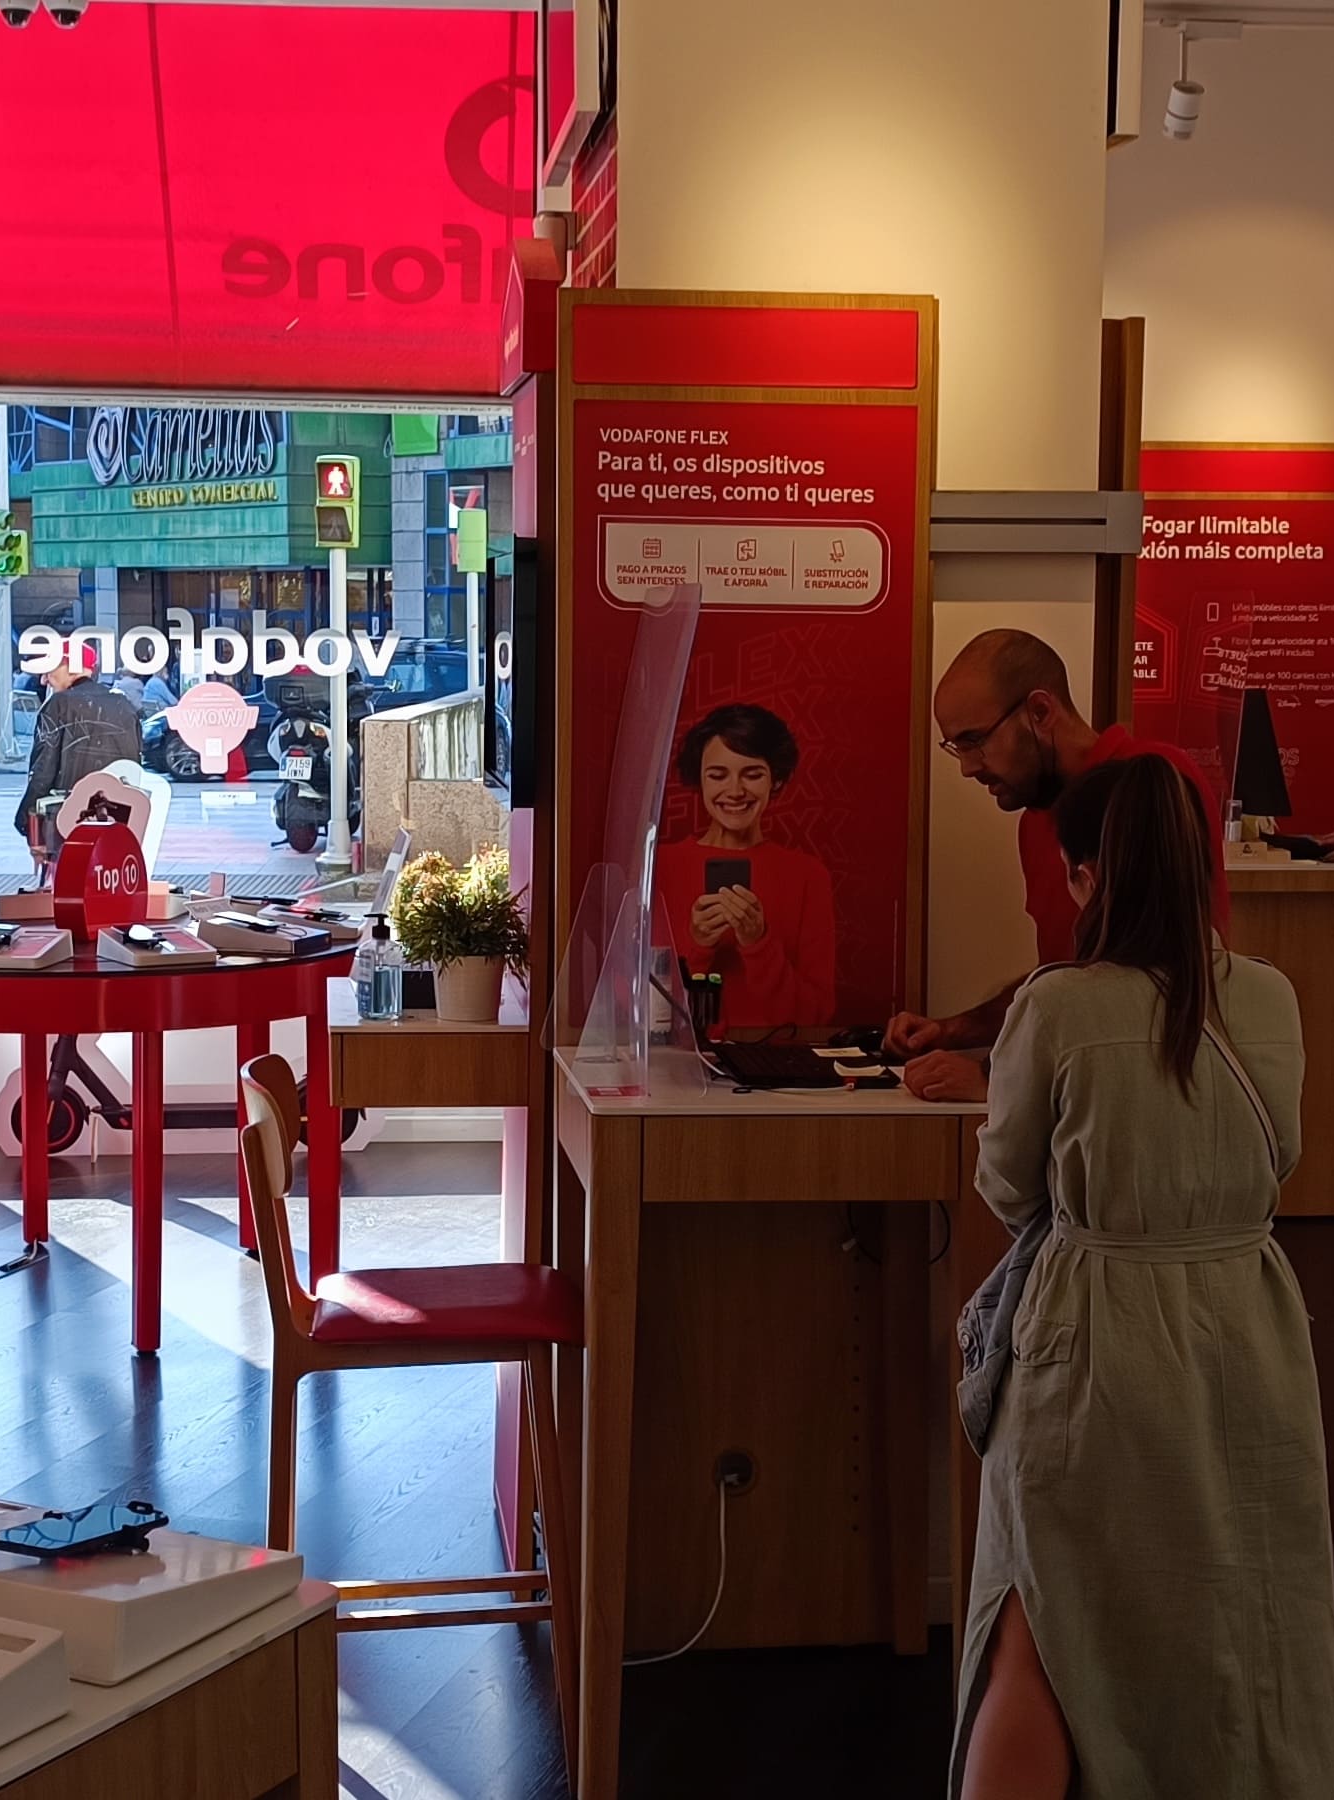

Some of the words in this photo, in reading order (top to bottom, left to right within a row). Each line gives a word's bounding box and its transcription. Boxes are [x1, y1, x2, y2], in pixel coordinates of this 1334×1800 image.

[599, 428, 687, 444] VODAFONE
[690, 430, 729, 445] FLEX
[598, 451, 643, 471] Para
[649, 453, 668, 474] ti,
[673, 457, 697, 473] os
[702, 454, 825, 478] dispositivos
[597, 482, 636, 502] que
[641, 484, 716, 503] queres,
[722, 486, 780, 502] como
[785, 483, 800, 502] ti
[804, 486, 875, 506] queres
[1142, 516, 1196, 538] Fogar
[1200, 516, 1290, 534] Ilimitable
[1185, 541, 1231, 560] máis
[1234, 543, 1324, 563] completa
[617, 565, 641, 574] PAGO
[642, 566, 649, 574] A
[650, 566, 687, 575] PRAZOS
[705, 566, 729, 576] TRAE
[739, 567, 757, 577] TEU
[758, 565, 787, 577] MÓBIL
[804, 567, 869, 578] SUBSTITUCIÓN
[617, 576, 636, 585] SEN
[637, 577, 687, 586] INTERESES
[811, 578, 869, 589] REPARACIÓN
[288, 758, 311, 769] 7159
[94, 865, 120, 895] Top
[124, 863, 137, 885] 10
